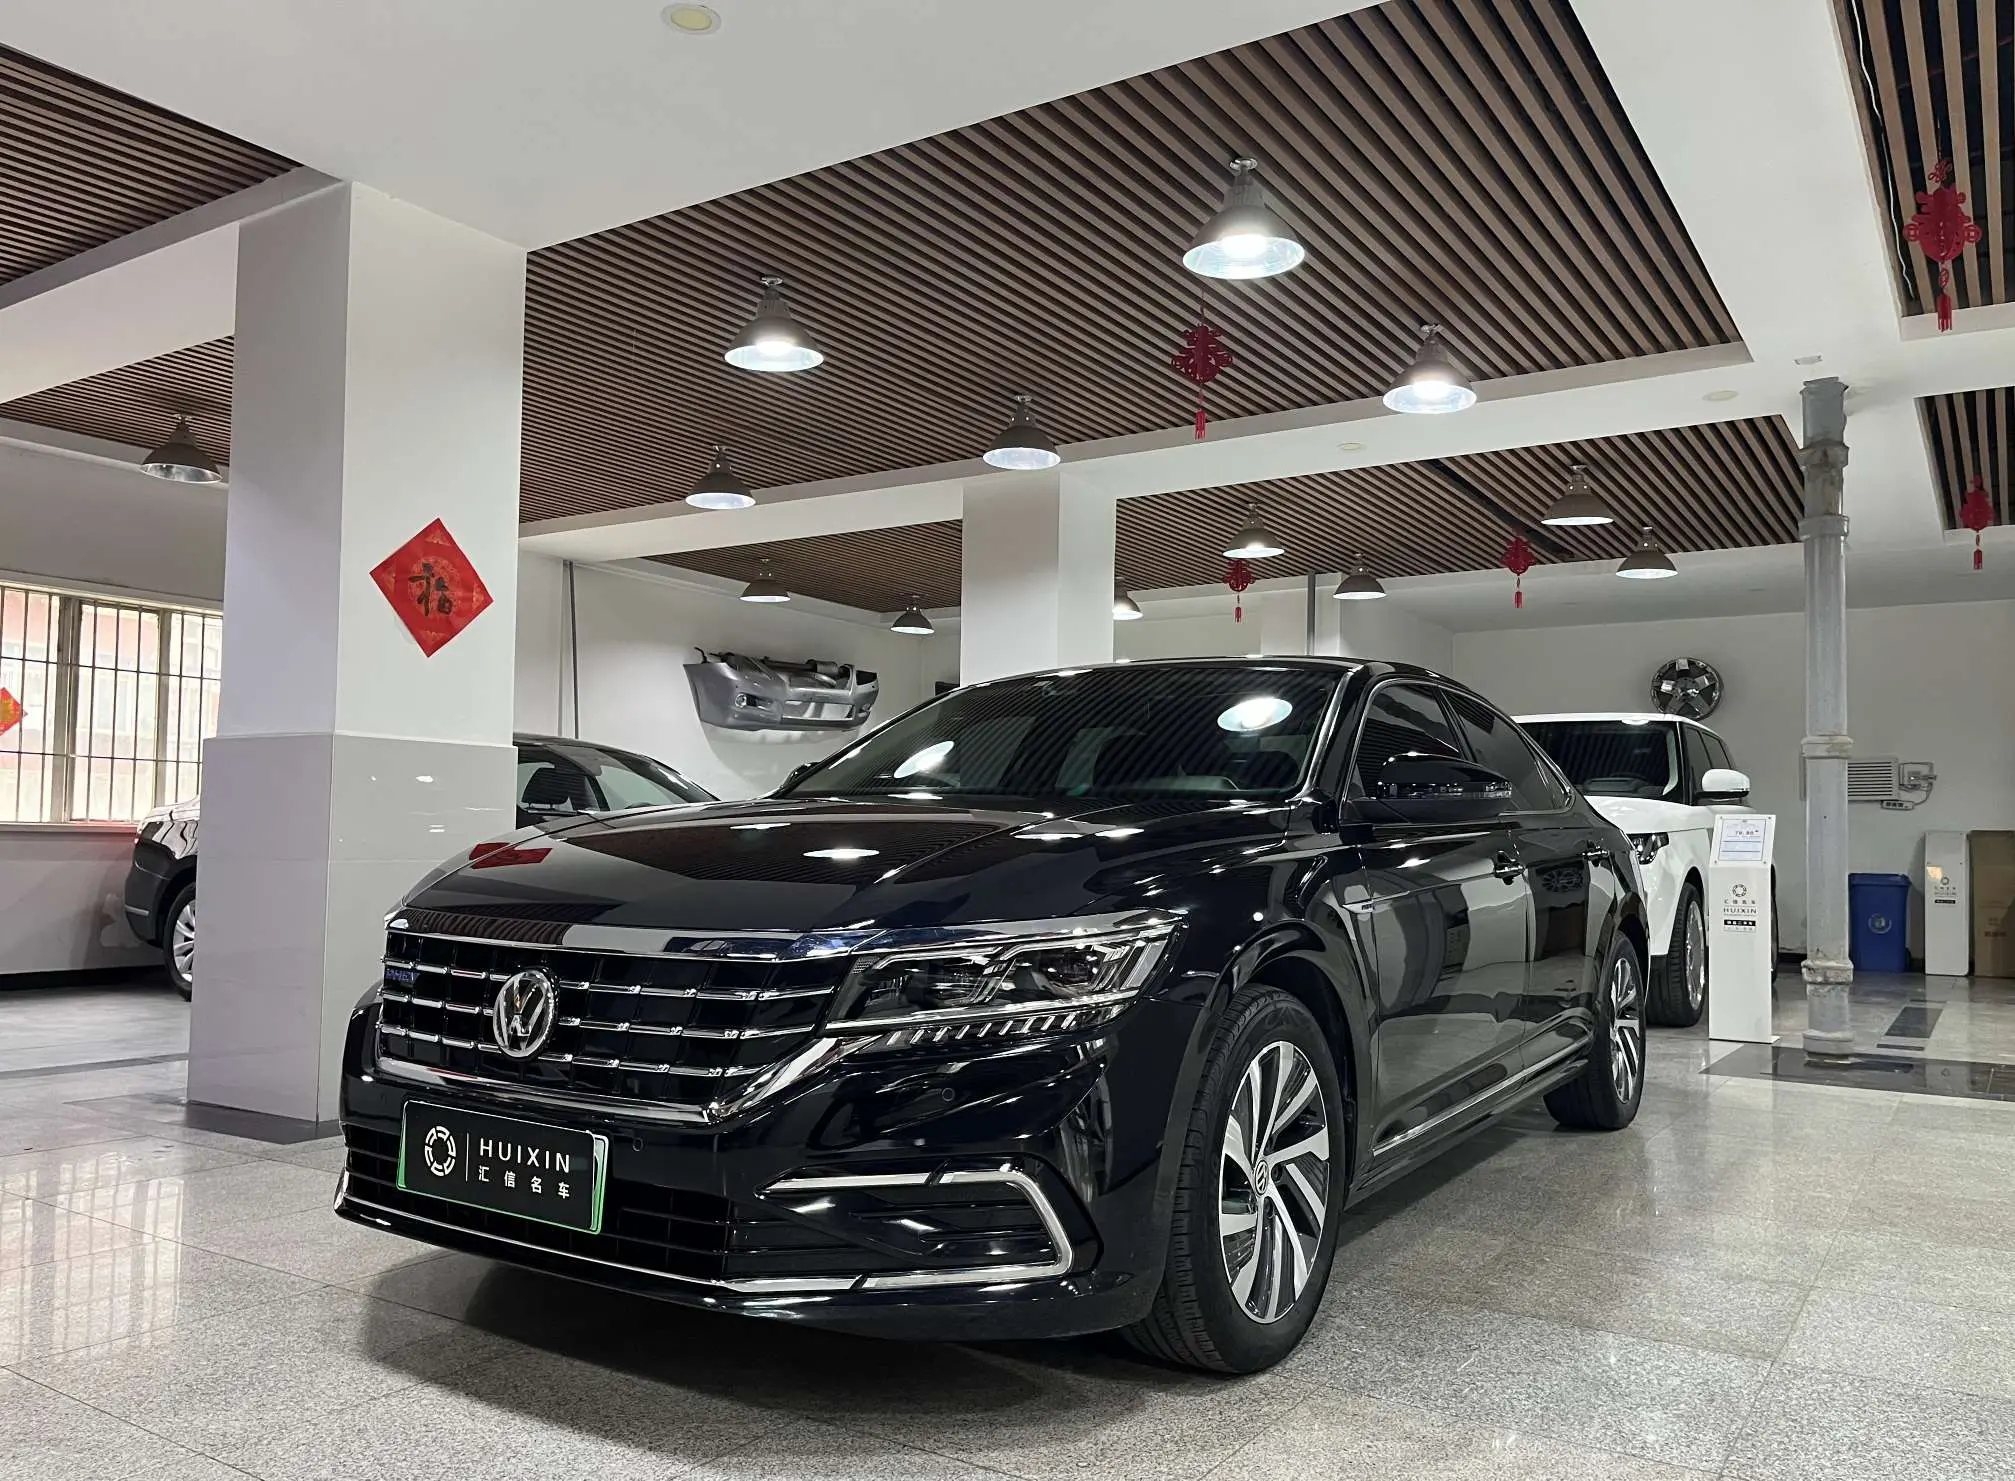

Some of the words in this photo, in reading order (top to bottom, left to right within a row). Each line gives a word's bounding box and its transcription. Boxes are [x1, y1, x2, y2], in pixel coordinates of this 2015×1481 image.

[408, 563, 455, 617] 福
[479, 1137, 570, 1174] HUIXIN
[478, 1165, 570, 1199] 汇信名车
